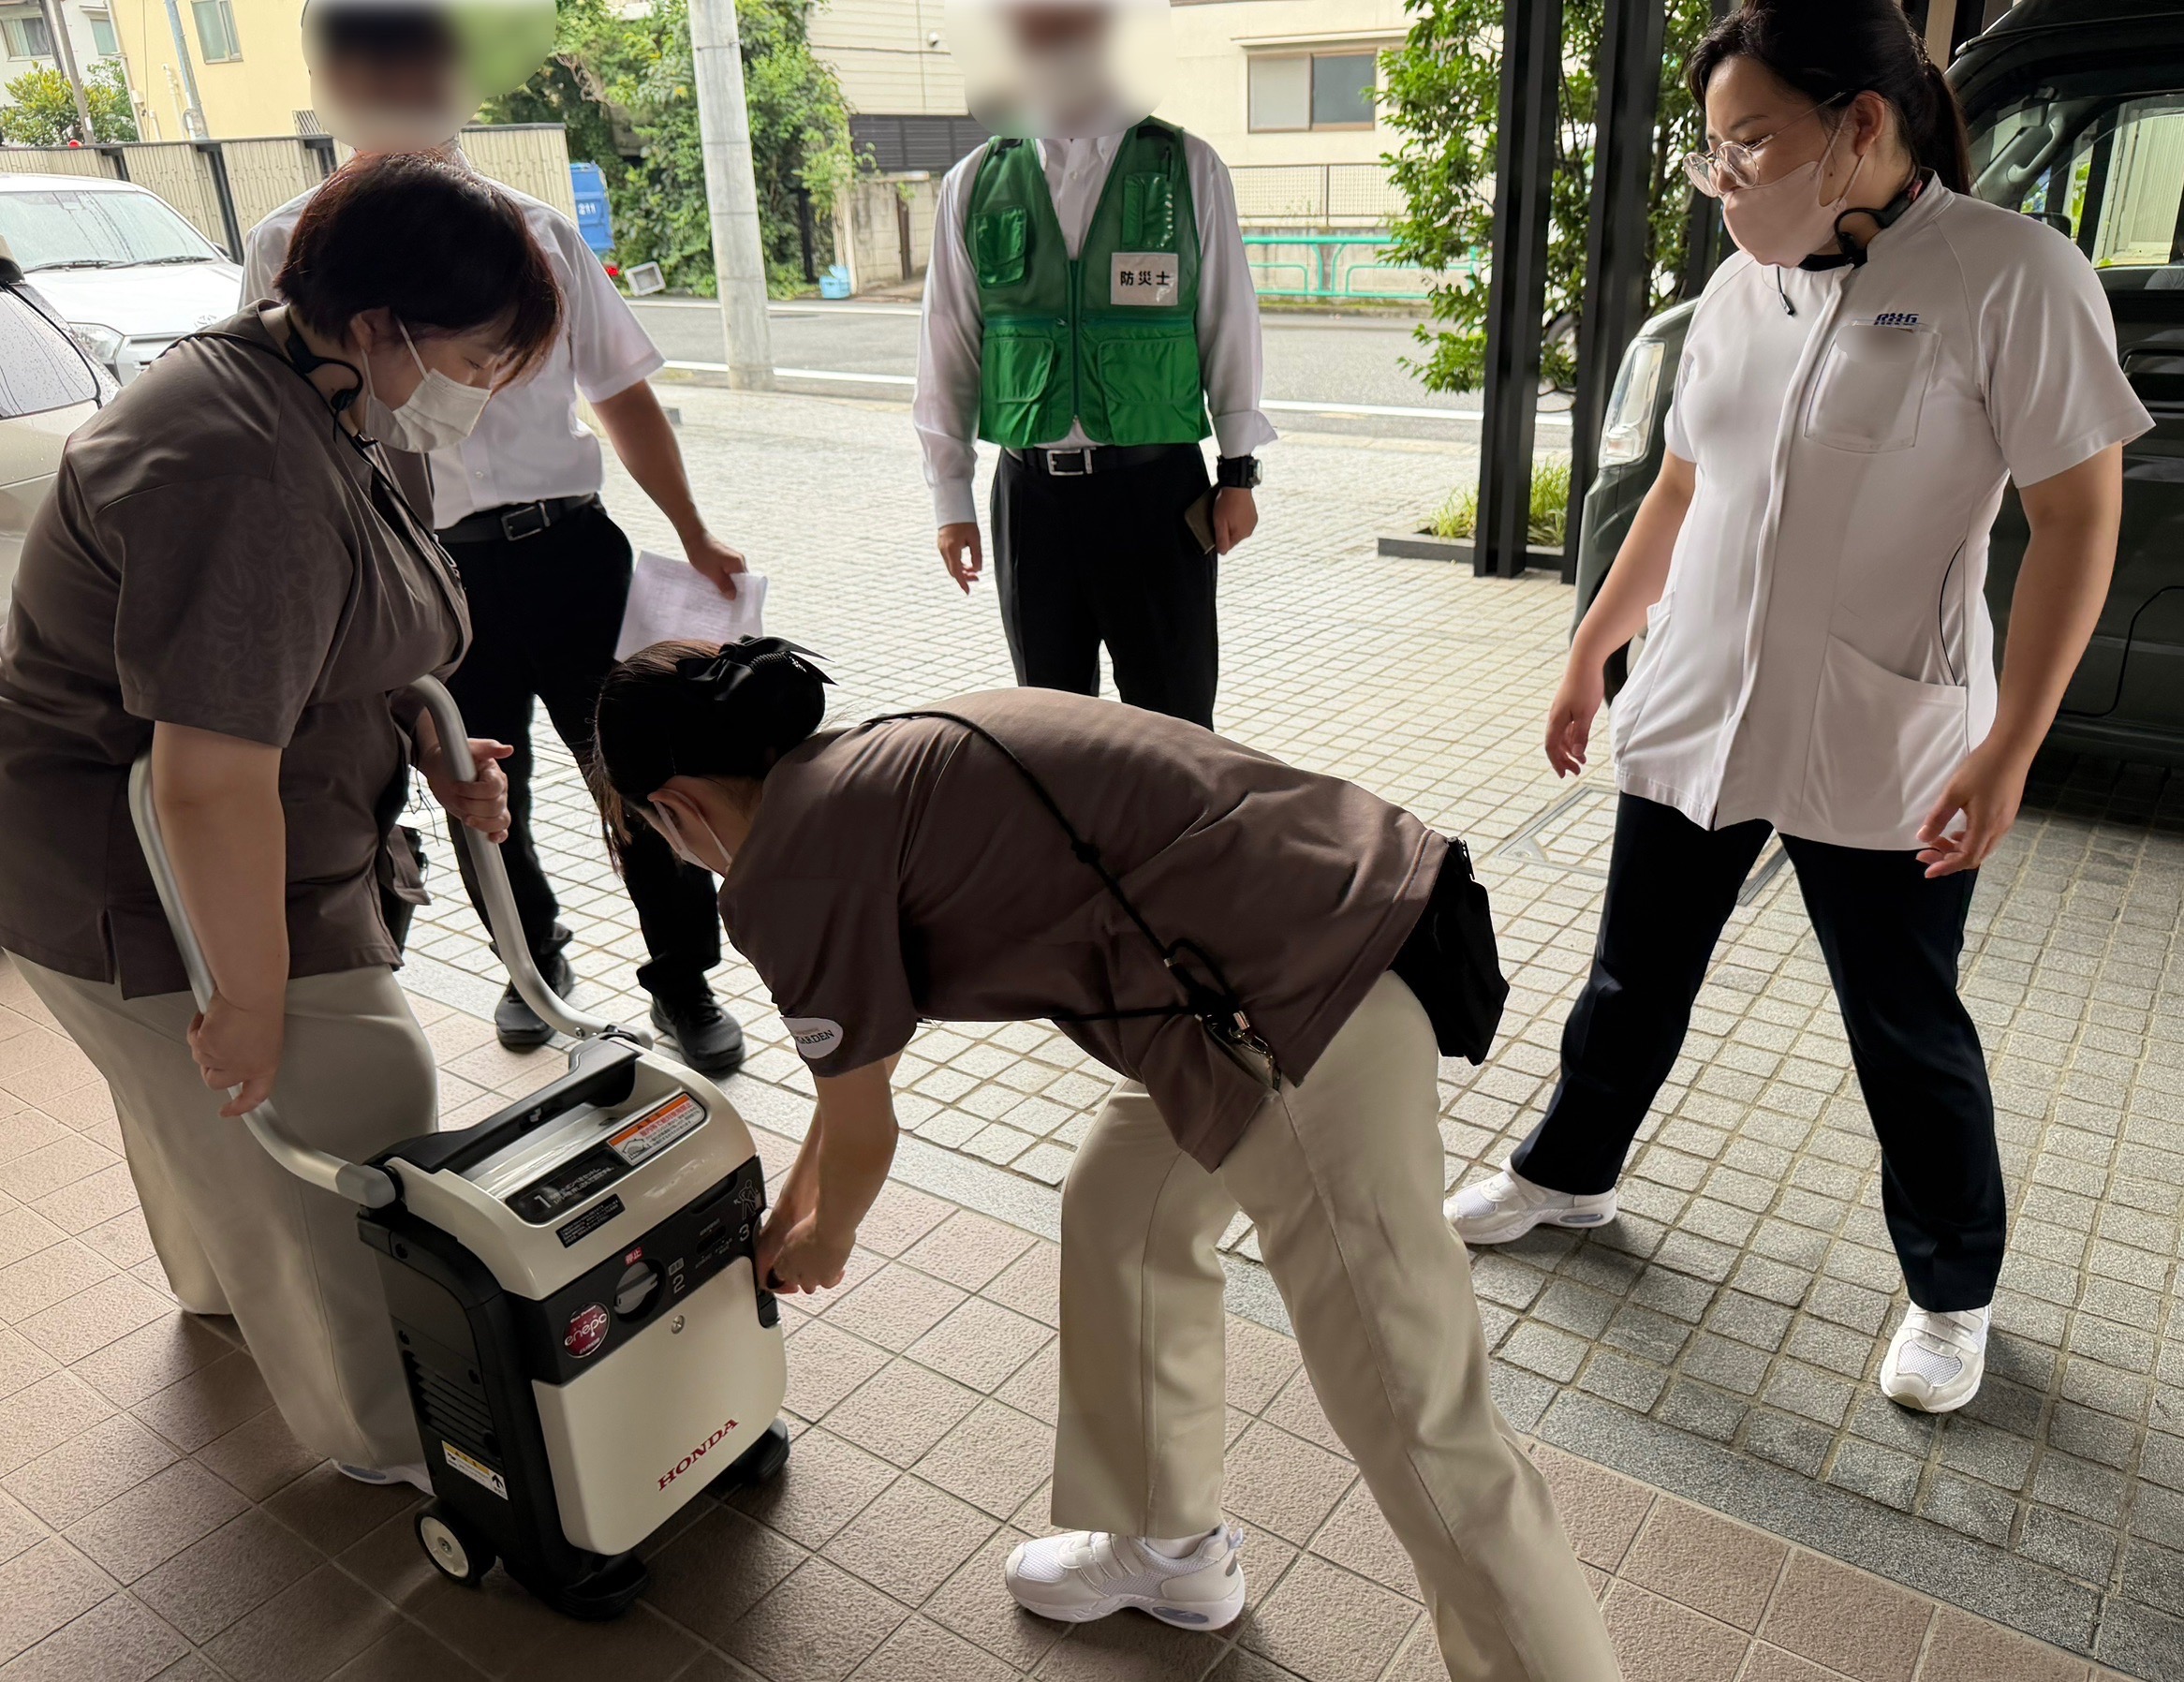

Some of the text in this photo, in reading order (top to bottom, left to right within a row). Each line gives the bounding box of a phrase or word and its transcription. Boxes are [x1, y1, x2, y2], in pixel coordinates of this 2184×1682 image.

[1120, 271, 1170, 286] 防災士
[534, 1194, 552, 1208] 1
[739, 1223, 749, 1242] 3
[672, 1274, 685, 1293] 2
[564, 1313, 607, 1346] enepo
[657, 1419, 739, 1491] HONDA
